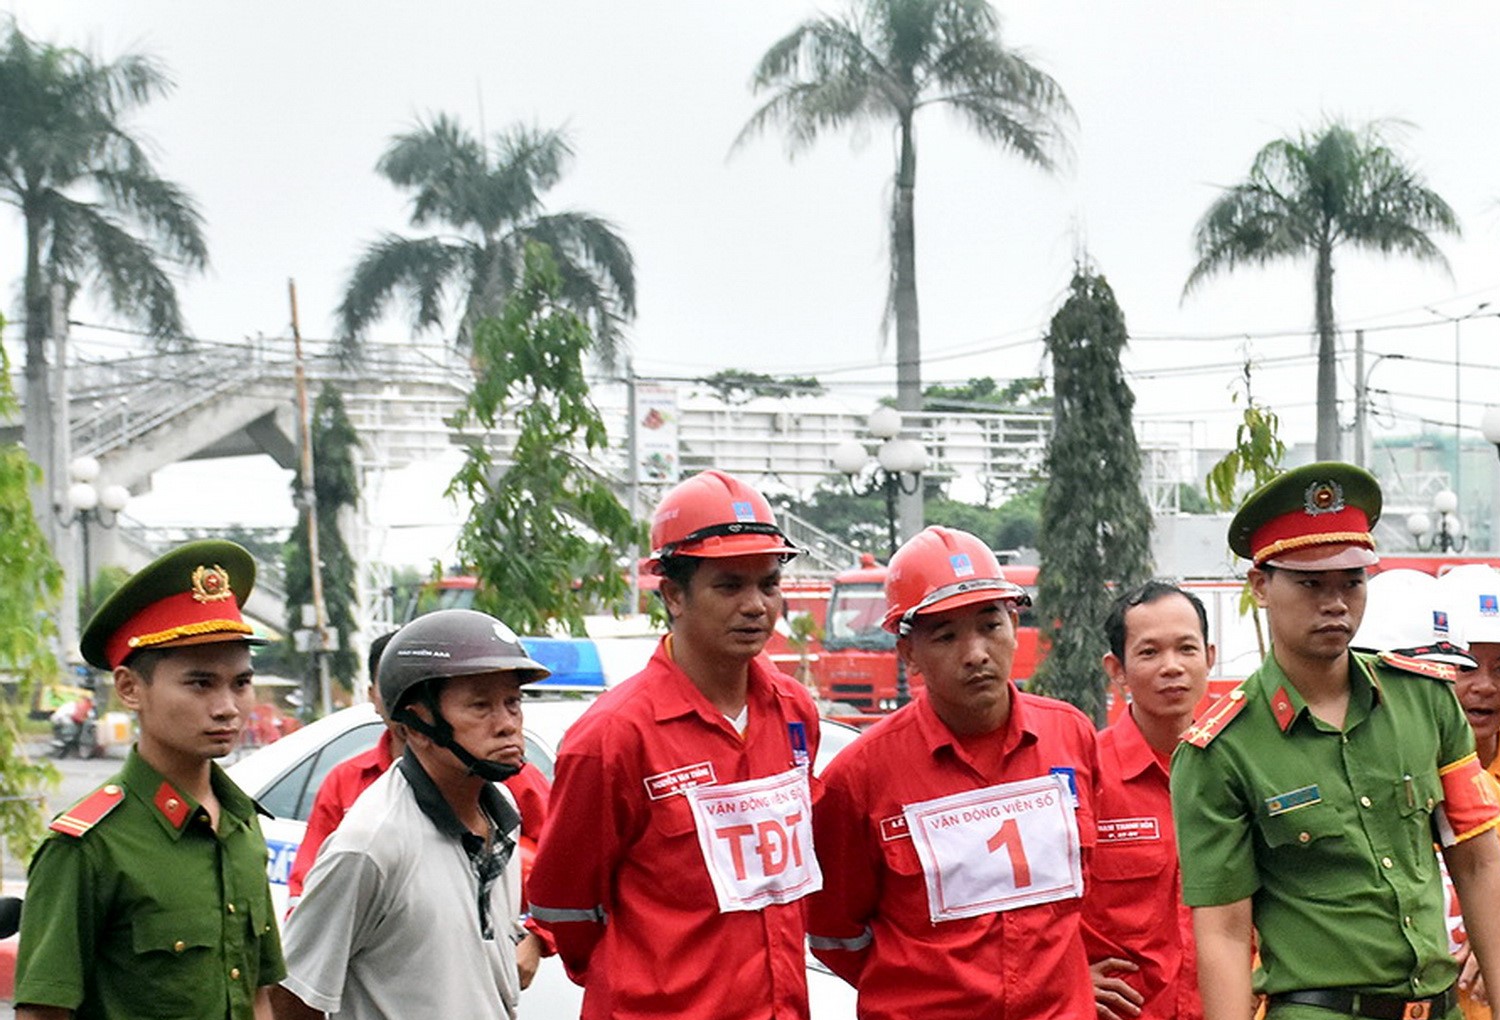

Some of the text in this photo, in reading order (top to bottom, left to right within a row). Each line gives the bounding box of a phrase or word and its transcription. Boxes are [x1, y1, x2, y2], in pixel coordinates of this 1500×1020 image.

[706, 801, 736, 818] VẬN
[739, 795, 771, 814] ĐỘNG
[931, 792, 1055, 831] VẬN ĐỘNG VIÊN SỐ
[986, 818, 1032, 889] 1
